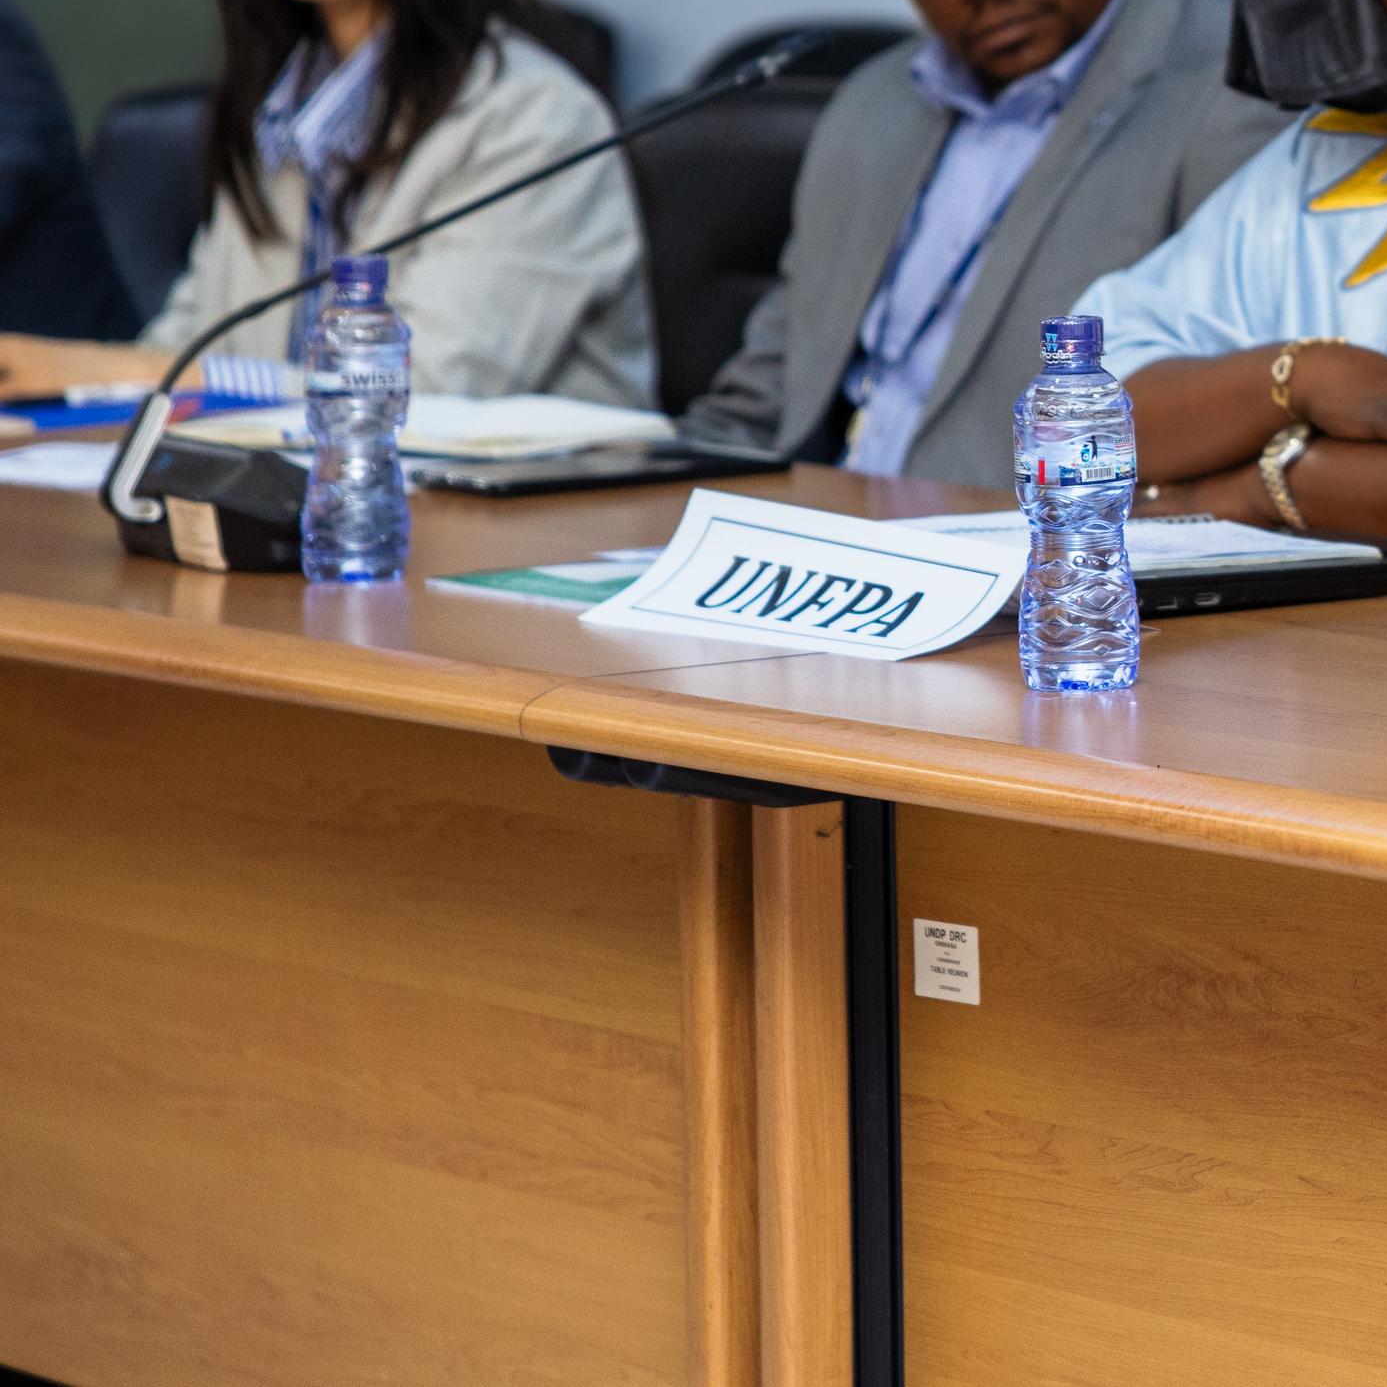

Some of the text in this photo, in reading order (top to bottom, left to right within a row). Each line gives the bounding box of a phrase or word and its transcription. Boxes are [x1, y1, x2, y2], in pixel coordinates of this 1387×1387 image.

[694, 555, 926, 638] UNFPA
[924, 926, 967, 943] UNDP DRC
